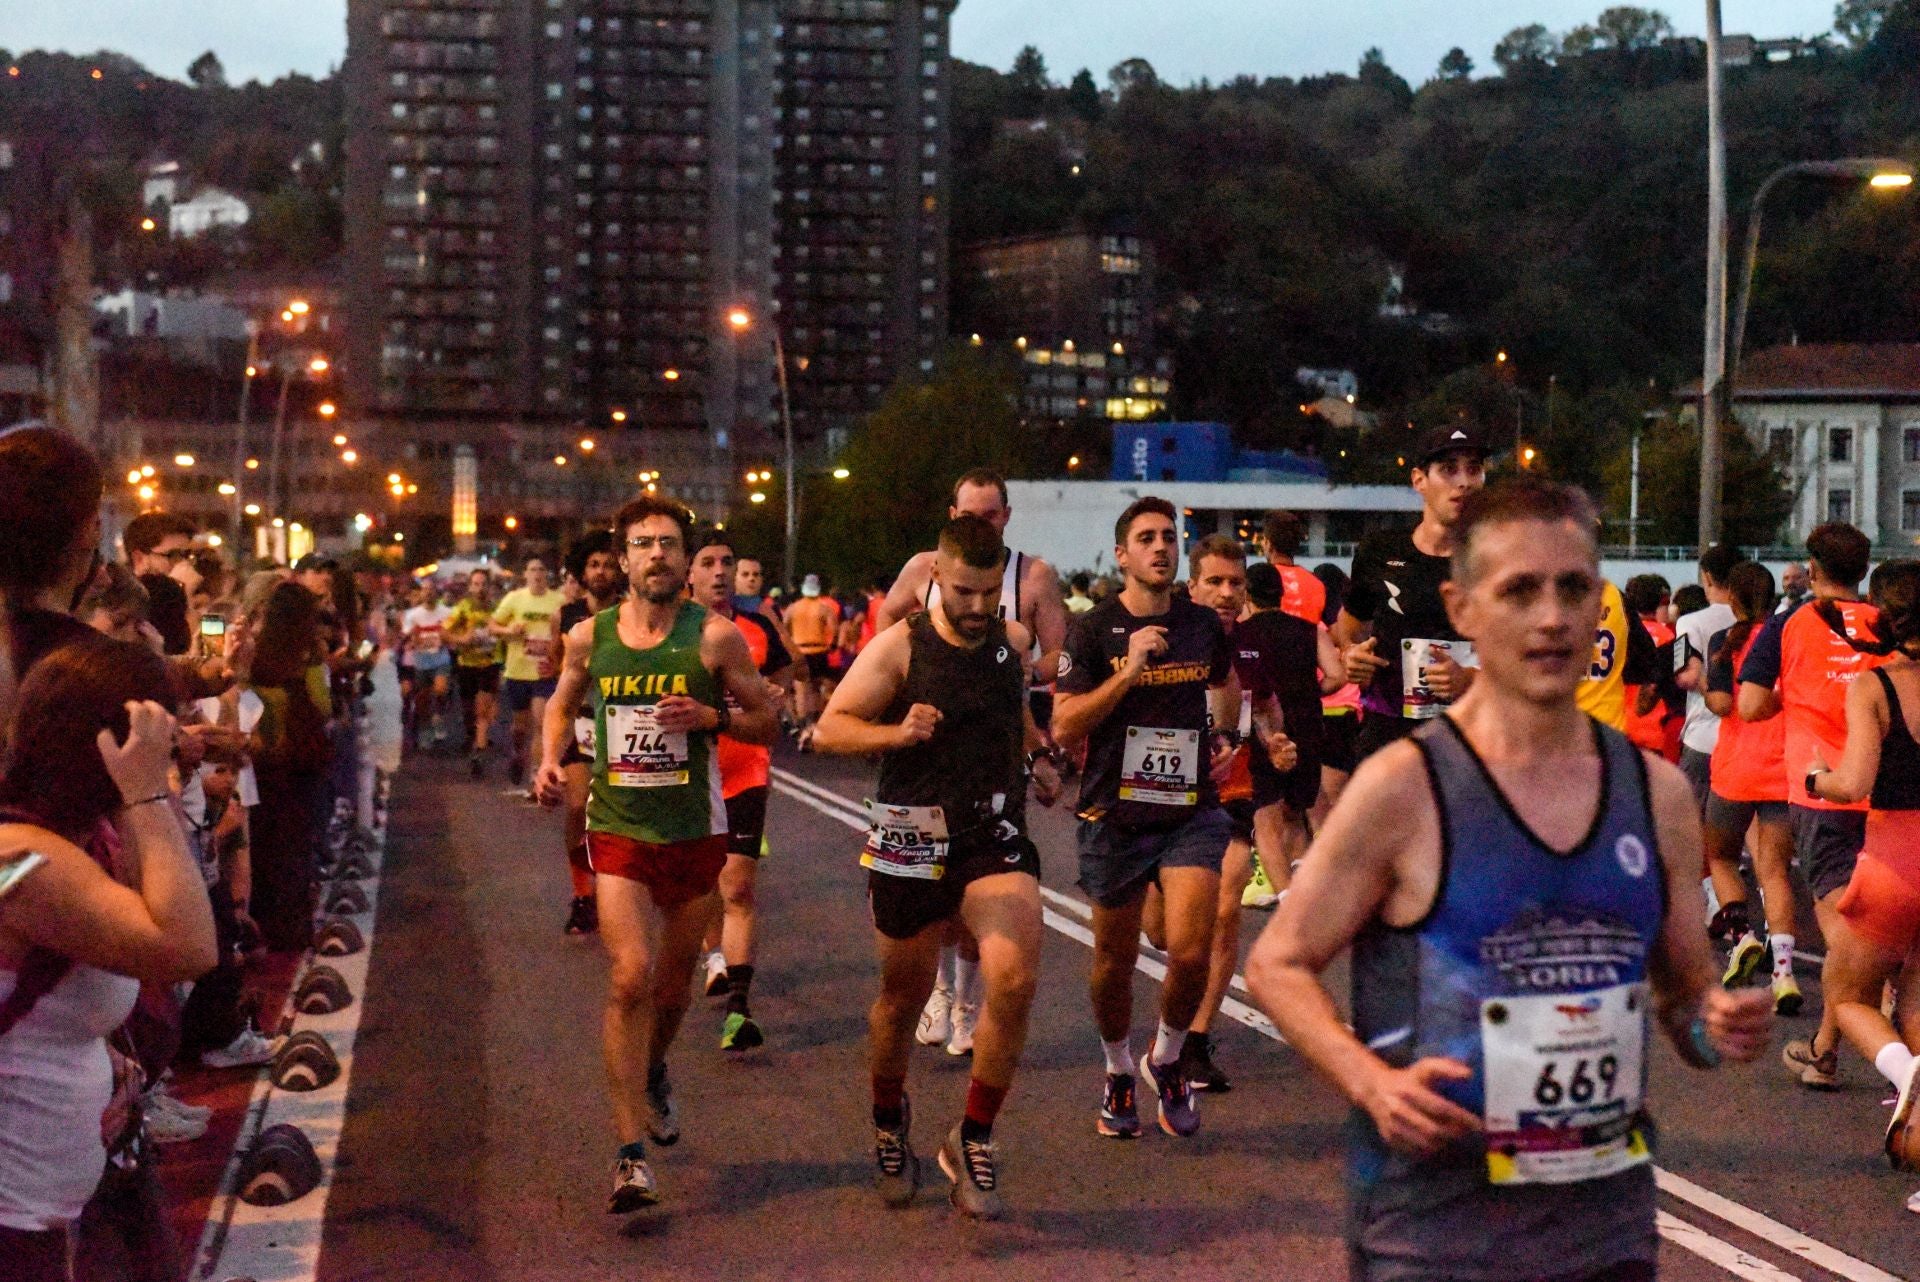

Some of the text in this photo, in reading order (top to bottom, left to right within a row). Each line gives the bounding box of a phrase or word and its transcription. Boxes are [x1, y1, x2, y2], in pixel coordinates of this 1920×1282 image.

[1588, 629, 1615, 678] 3
[600, 675, 688, 697] BIKILA
[625, 733, 668, 753] 744
[1142, 754, 1181, 773] 619
[881, 826, 935, 846] 2085
[1535, 1055, 1618, 1106] 669
